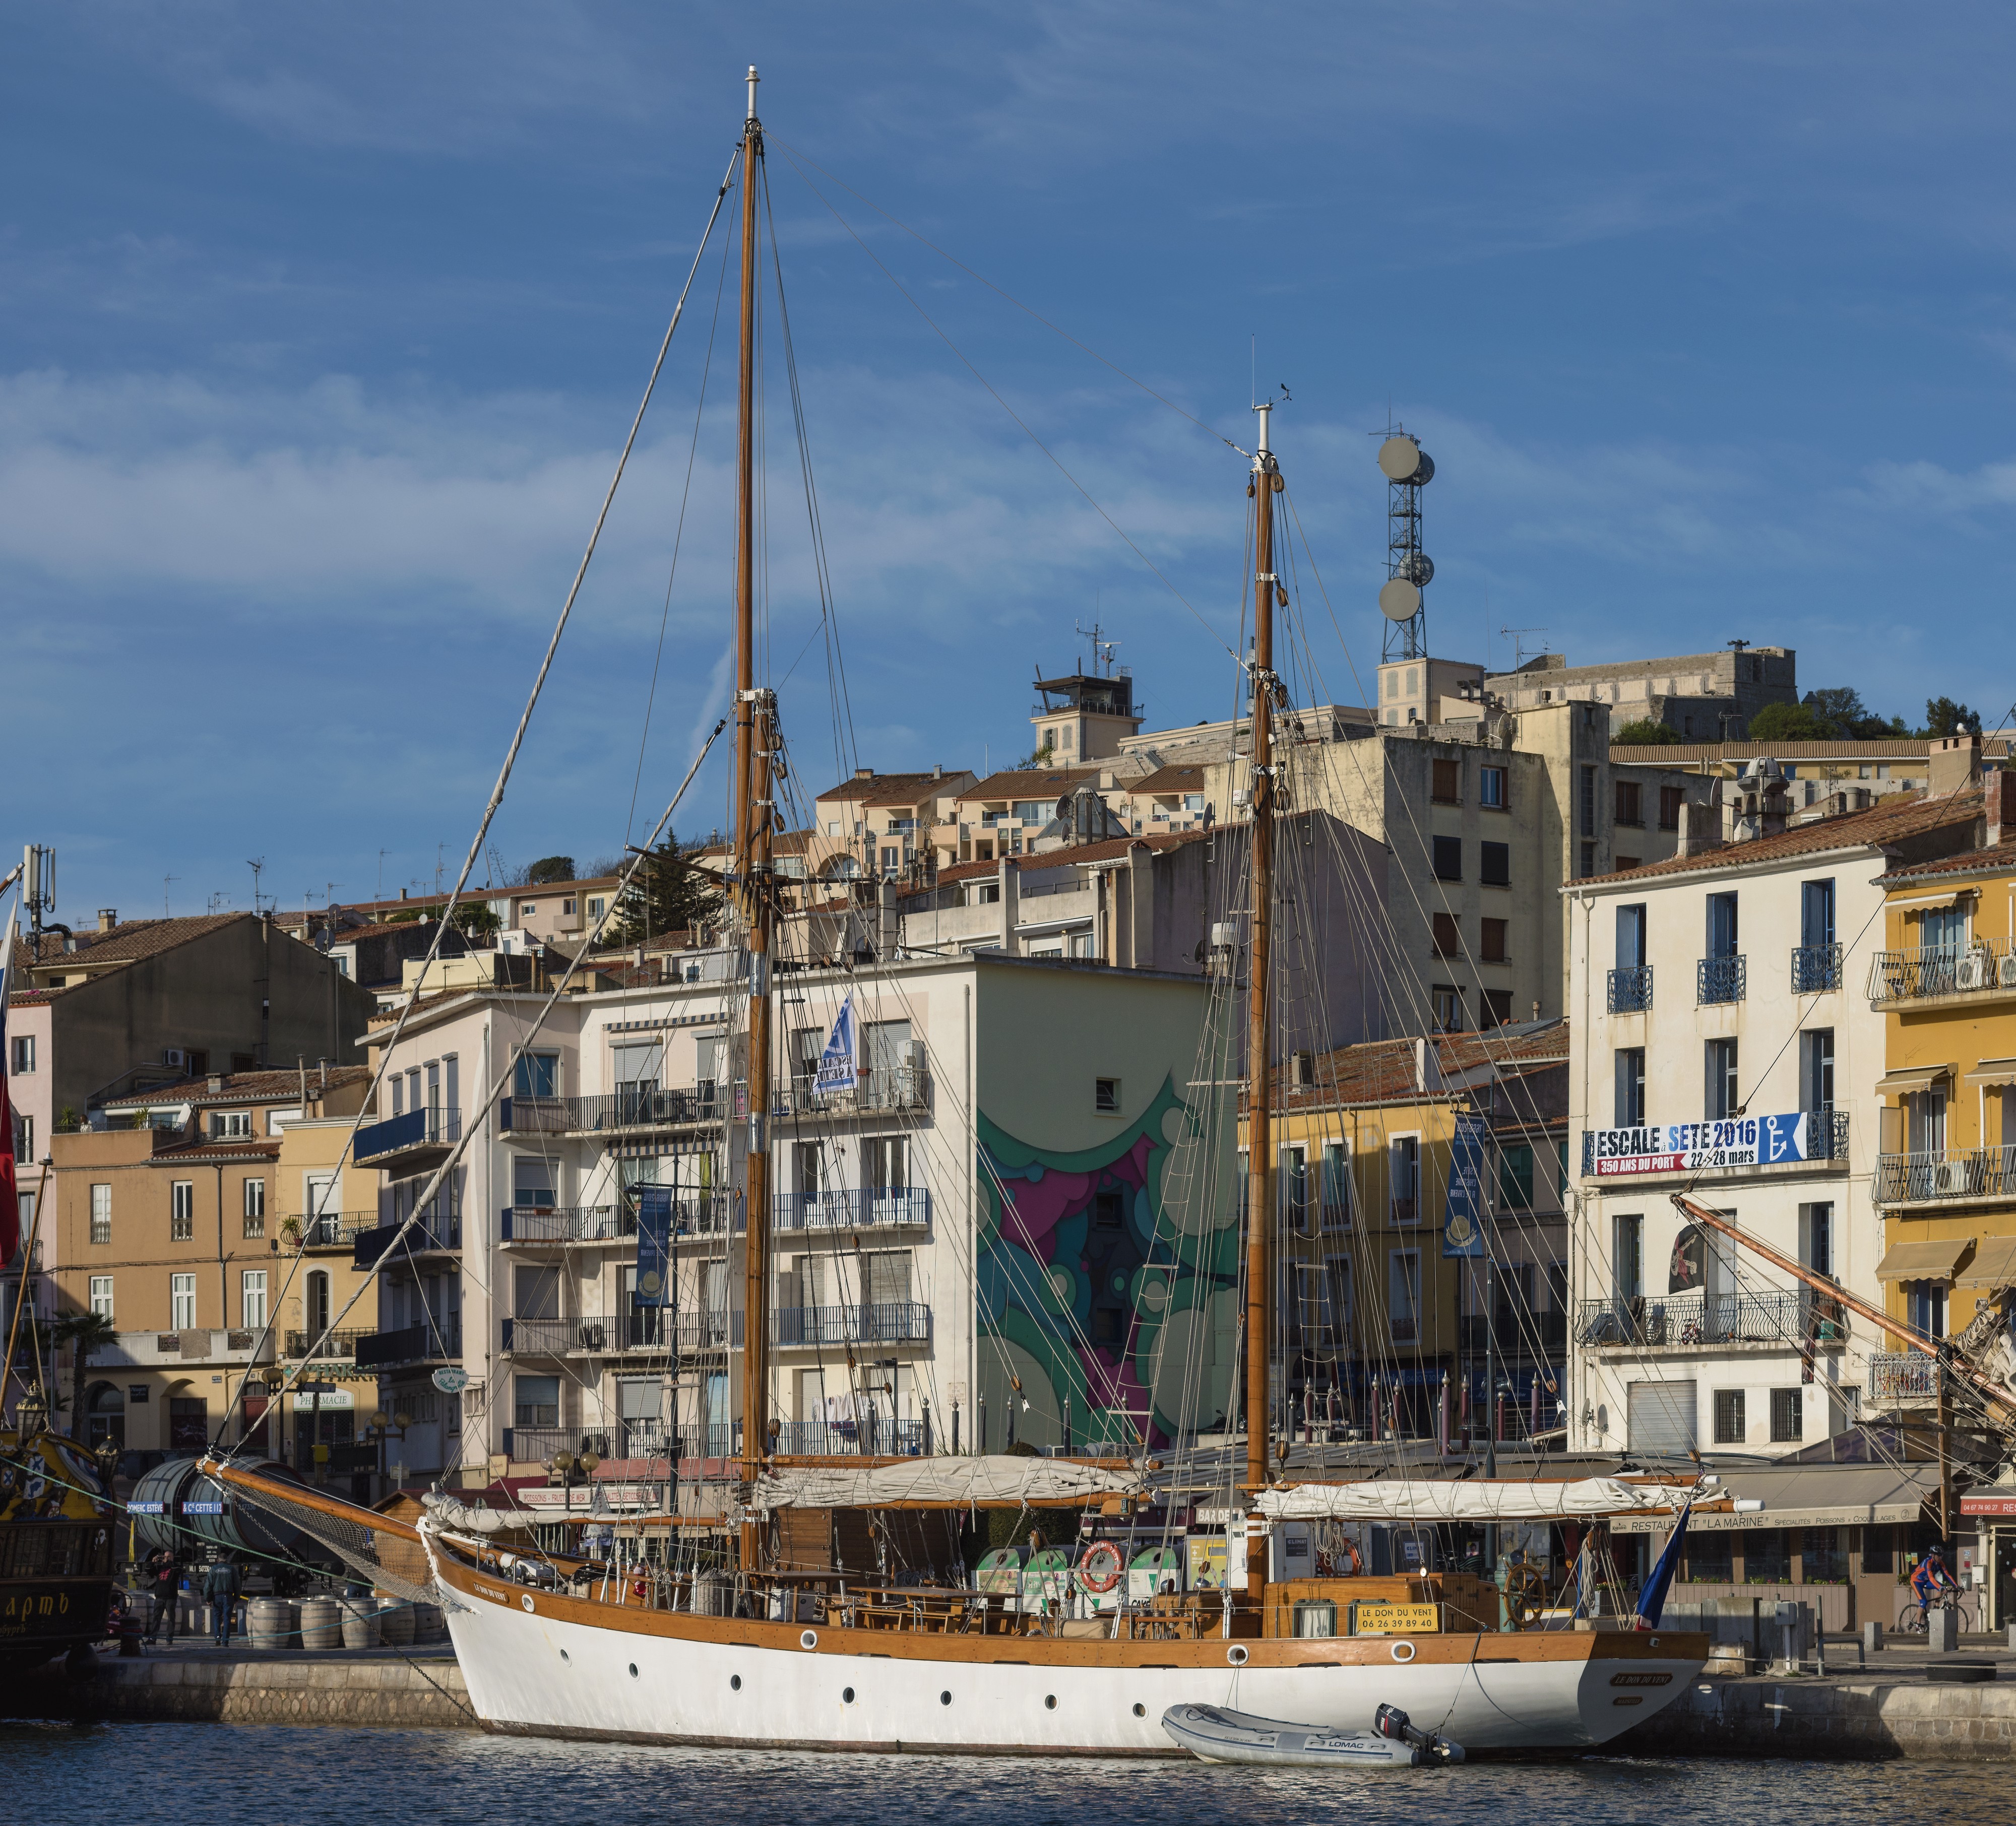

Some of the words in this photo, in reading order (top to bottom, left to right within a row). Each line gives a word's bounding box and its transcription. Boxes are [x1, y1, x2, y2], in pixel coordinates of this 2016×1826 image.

[1597, 1127, 1660, 1157] ESCALE
[1661, 1142, 1666, 1152] à
[1668, 1123, 1710, 1152] SETE
[1714, 1120, 1756, 1148] 2016
[1601, 1160, 1618, 1173] 350
[1619, 1158, 1636, 1172] ANS
[1638, 1158, 1650, 1170] DU
[1652, 1156, 1675, 1169] PORT
[1691, 1152, 1703, 1167] 22
[1713, 1151, 1725, 1165] 28
[1729, 1150, 1754, 1164] mars
[524, 1494, 546, 1502] POISSONS
[576, 1493, 585, 1502] MER
[127, 1504, 146, 1512] DOMERC
[147, 1502, 163, 1512] ESTÈVE
[183, 1504, 187, 1512] &
[196, 1504, 212, 1512] CETTE
[214, 1504, 222, 1512] 112
[1198, 1510, 1217, 1522] BAR
[1218, 1509, 1230, 1522] DE
[1775, 1518, 1811, 1526] SPÉCIALITÉS
[474, 1583, 480, 1592] LE
[479, 1586, 488, 1595] DON
[487, 1589, 494, 1597] DU
[493, 1591, 506, 1601] VENT
